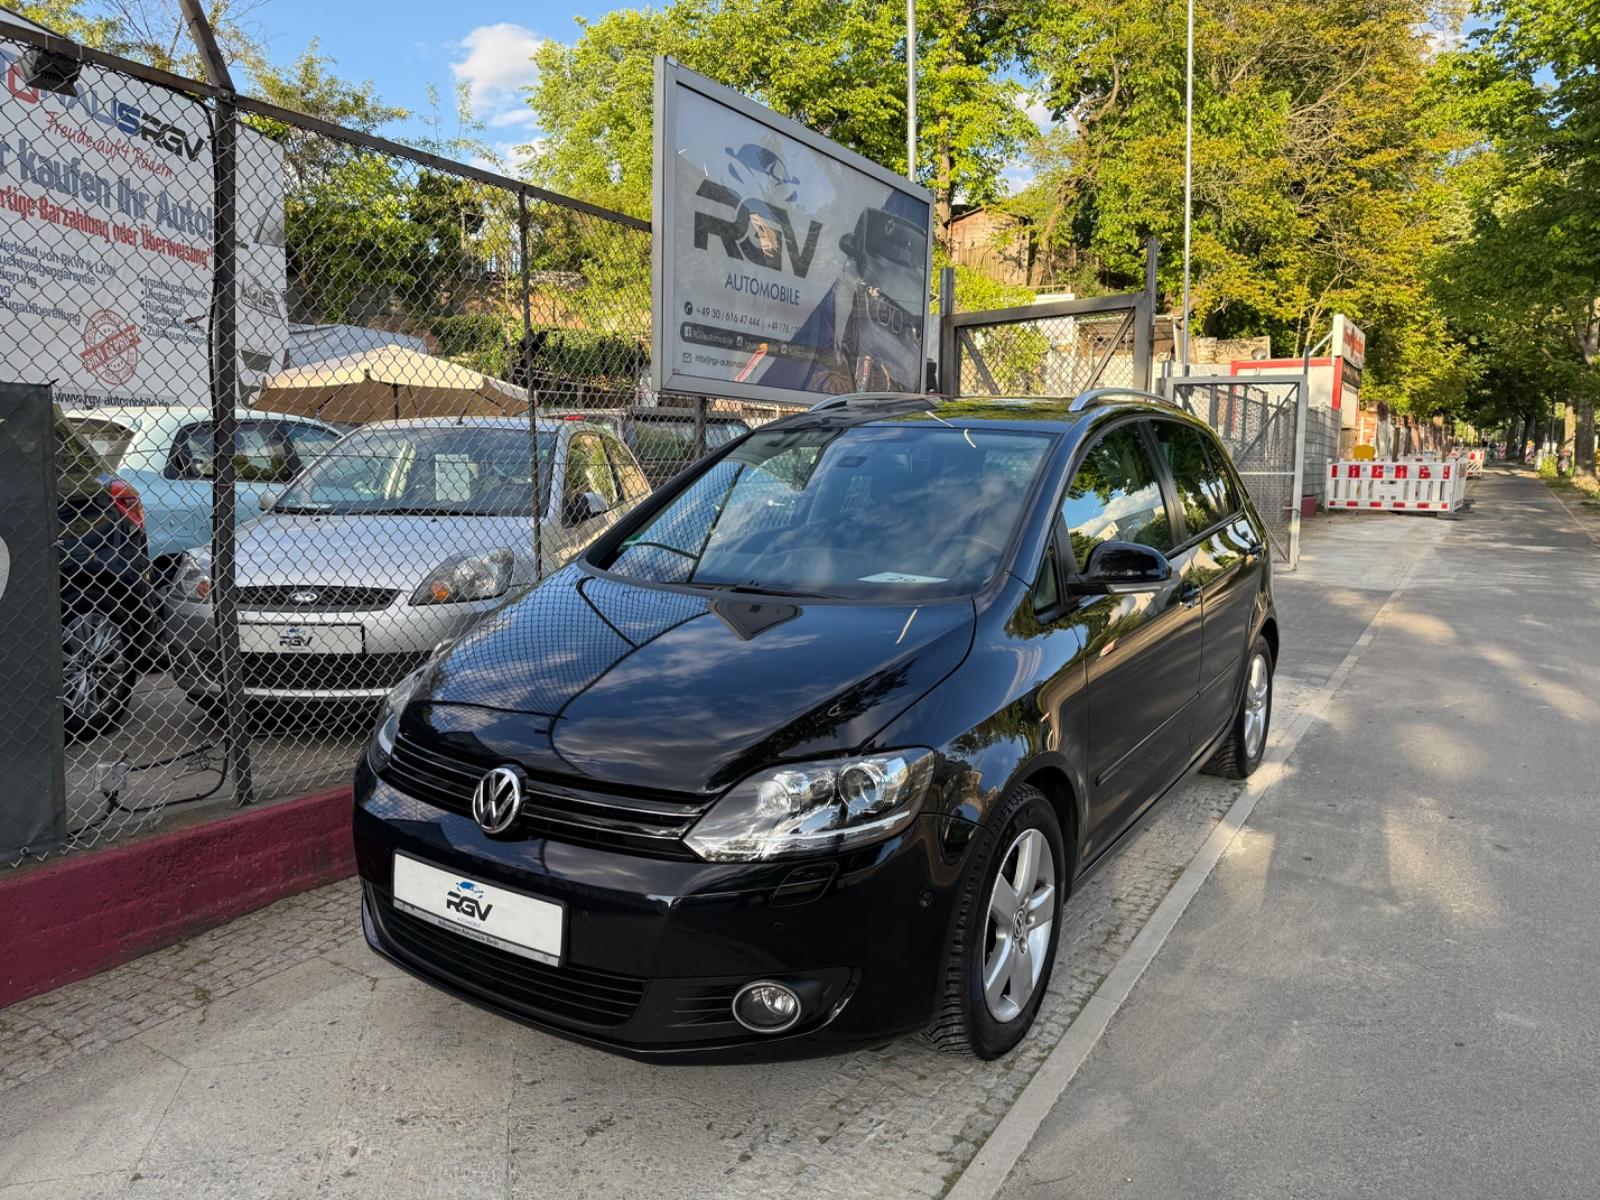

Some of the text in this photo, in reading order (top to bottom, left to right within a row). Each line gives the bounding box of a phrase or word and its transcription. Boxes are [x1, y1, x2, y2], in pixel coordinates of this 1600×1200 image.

[46, 111, 93, 148] Freude
[95, 138, 121, 162] auf
[131, 147, 173, 179] Rädern
[19, 138, 111, 208] kaufen
[118, 175, 149, 220] Ihr
[157, 190, 213, 241] Auto!
[40, 195, 110, 244] Barzahlung
[113, 221, 138, 247] oder
[694, 178, 824, 280] RGV
[40, 250, 60, 264] von
[725, 273, 800, 306] AUTOMOBILE
[712, 309, 721, 320] 30
[725, 311, 738, 323] 616
[447, 891, 493, 921] RGV
